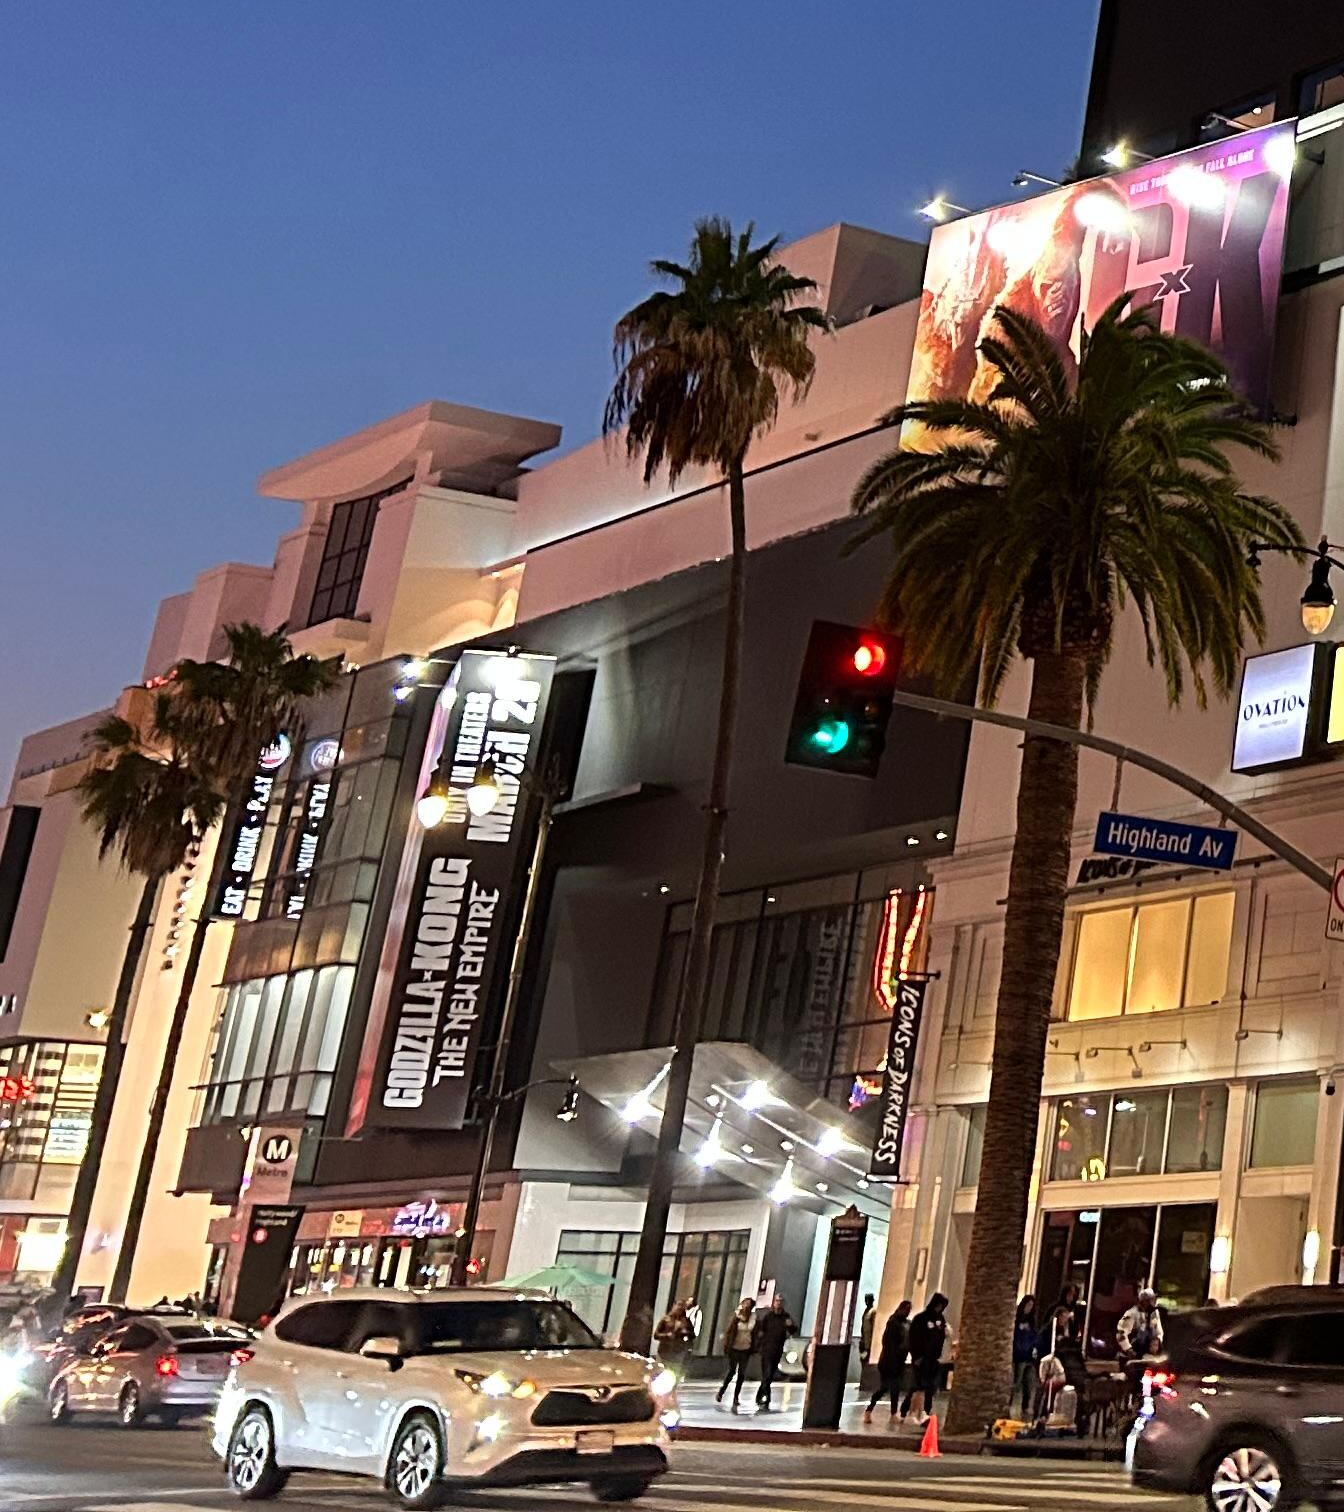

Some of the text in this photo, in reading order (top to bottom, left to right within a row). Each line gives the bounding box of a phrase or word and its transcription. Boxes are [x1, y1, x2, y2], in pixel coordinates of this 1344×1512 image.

[454, 691, 493, 762] THEATERS
[450, 765, 477, 784] IN
[466, 730, 531, 843] MARCH
[231, 825, 262, 873] DRINK
[1108, 821, 1223, 858] Highland Av
[221, 886, 246, 915] EAT
[410, 857, 473, 971] KONG
[1330, 917, 1344, 933] ON
[432, 879, 500, 1088] THE NEW EMPIRE
[383, 980, 447, 1109] GODZILLA
[894, 984, 921, 1048] ICONS
[875, 1066, 909, 1165] DARKNESS
[256, 1162, 288, 1178] Metro
